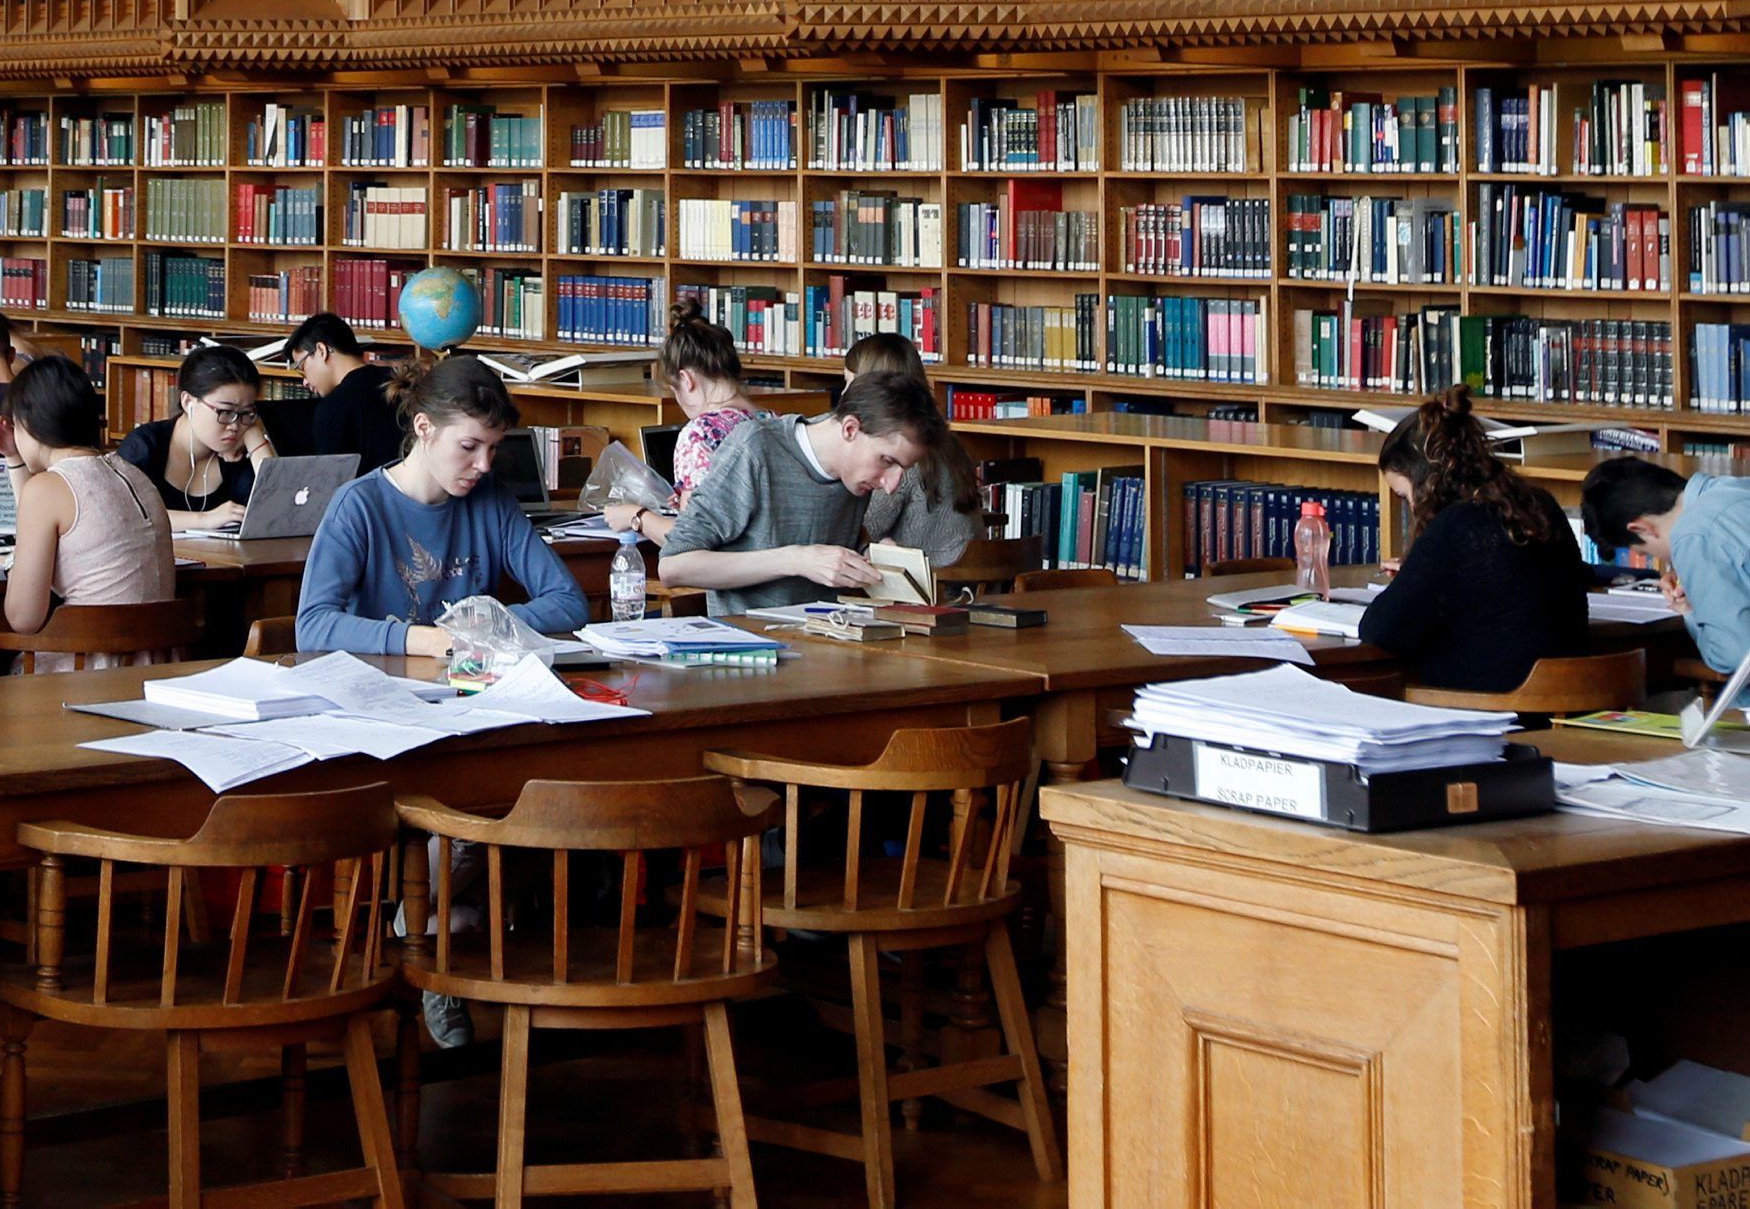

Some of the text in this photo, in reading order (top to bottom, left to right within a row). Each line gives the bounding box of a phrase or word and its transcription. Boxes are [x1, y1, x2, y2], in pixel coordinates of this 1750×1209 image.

[1220, 753, 1293, 776] KLADPAPIER
[1217, 787, 1298, 812] SCRAP PAPER
